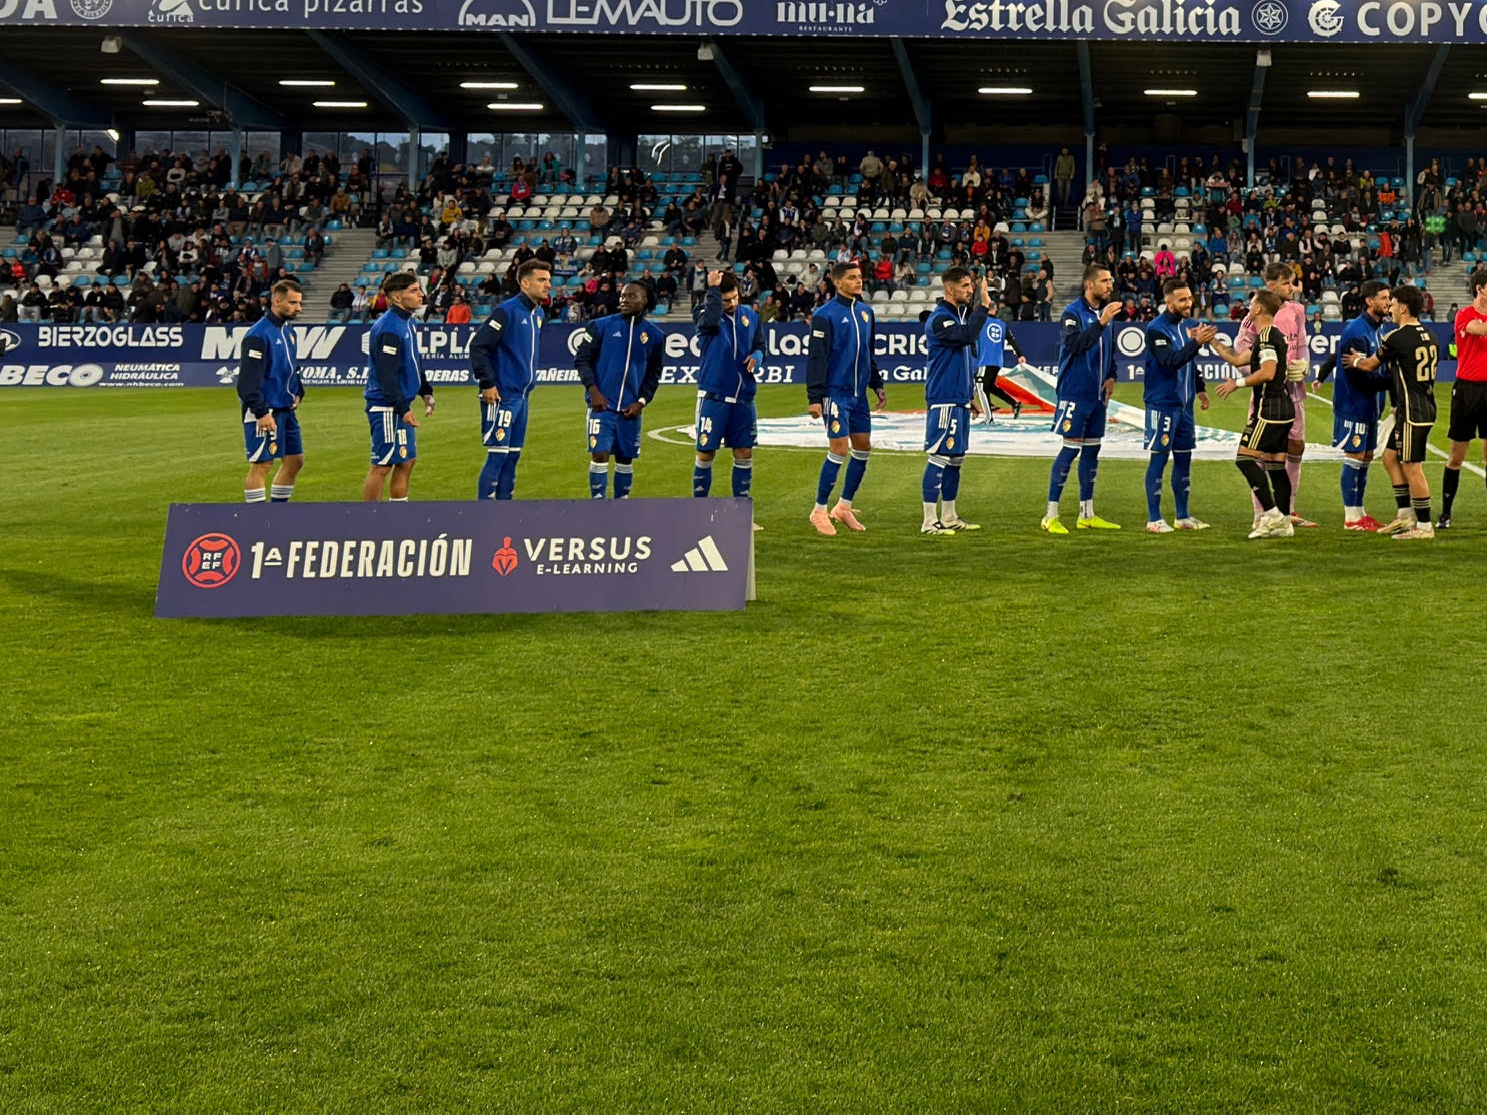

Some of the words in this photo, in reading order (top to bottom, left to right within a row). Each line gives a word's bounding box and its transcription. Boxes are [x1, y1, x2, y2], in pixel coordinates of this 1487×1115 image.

[465, 13, 530, 26] MAN
[38, 326, 183, 347] BIERZOGLASS
[114, 363, 180, 371] NEUMÁTICA
[1415, 345, 1437, 382] 22
[0, 364, 104, 386] BECO
[110, 370, 178, 380] HIDRÁULICA
[1066, 402, 1075, 418] 2
[498, 409, 512, 428] 19
[589, 418, 600, 434] 16
[700, 416, 712, 433] 14
[950, 418, 957, 435] 5
[1163, 416, 1171, 432] 3
[396, 429, 408, 445] 18
[201, 551, 222, 561] RF
[286, 533, 473, 578] FEDERACIÓN
[523, 535, 652, 562] VERSUS
[201, 561, 220, 570] EF
[536, 561, 638, 575] E-LEARNING
